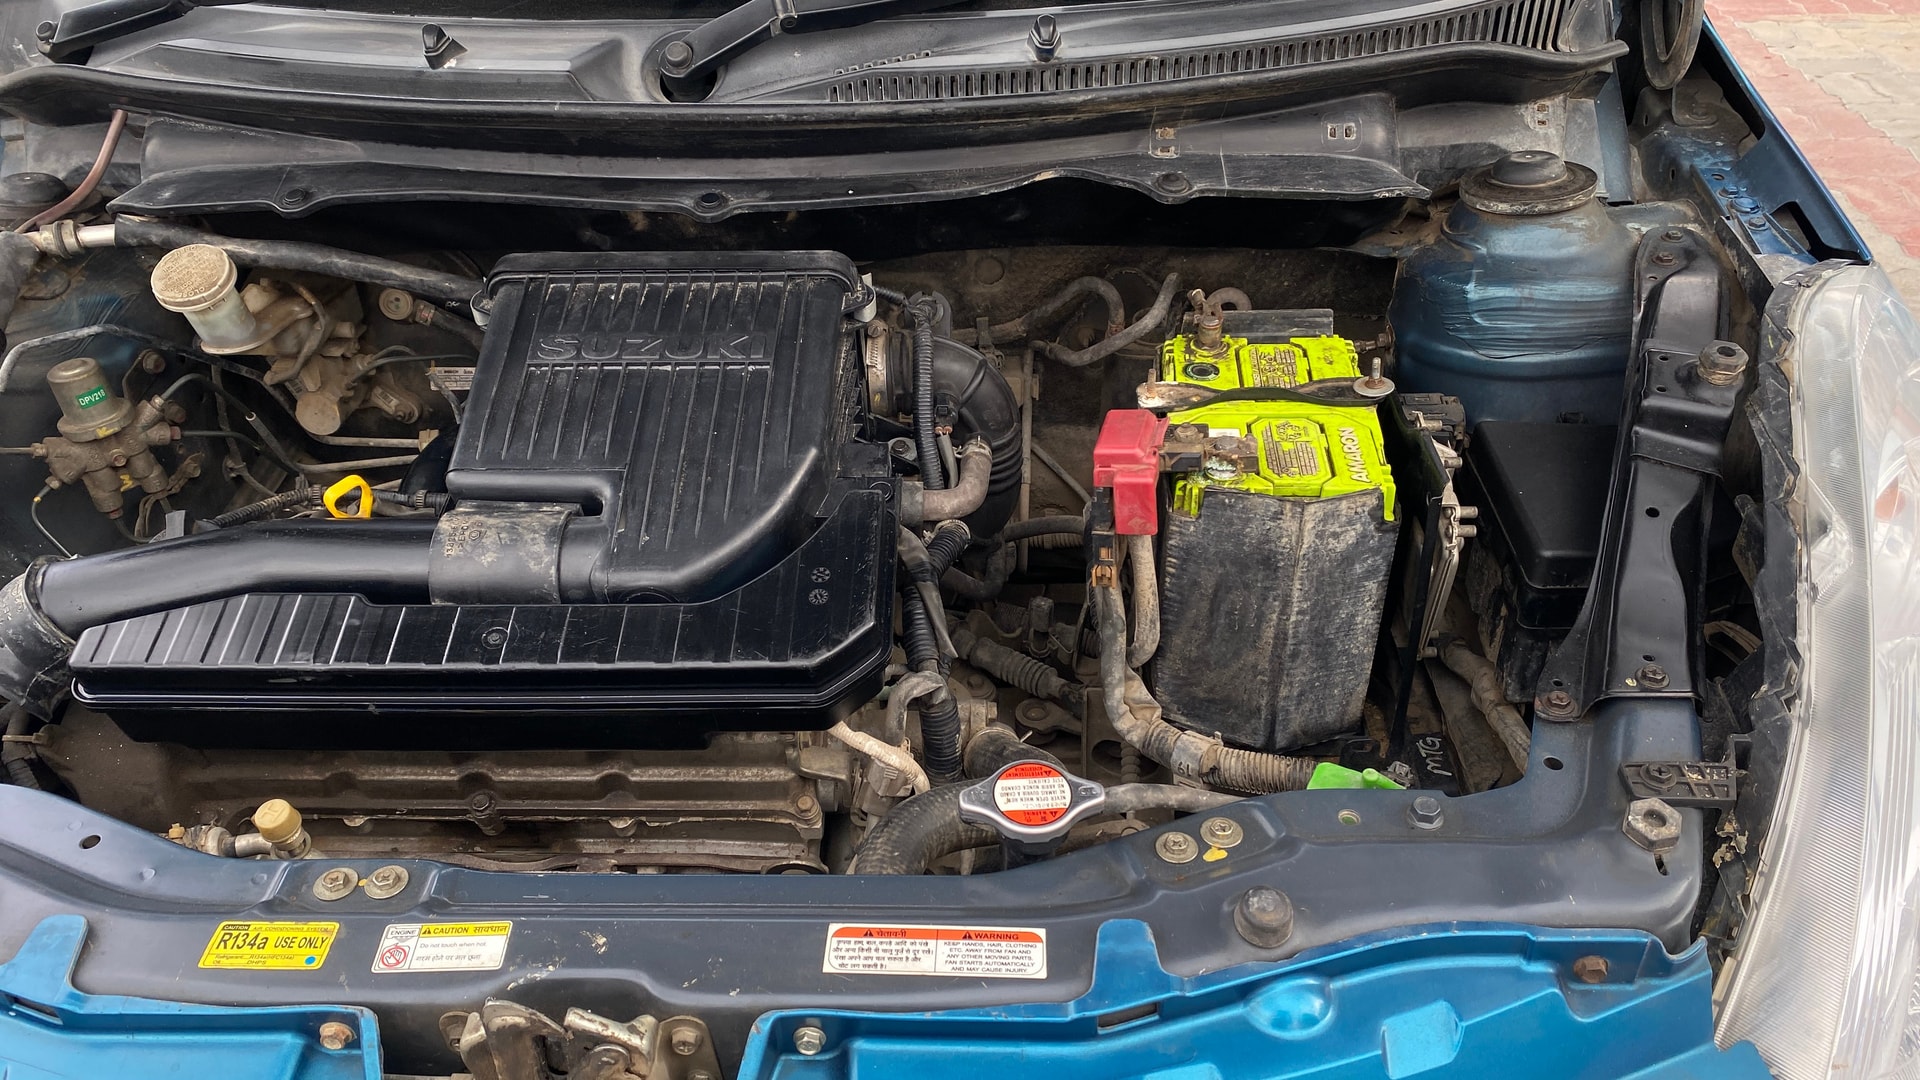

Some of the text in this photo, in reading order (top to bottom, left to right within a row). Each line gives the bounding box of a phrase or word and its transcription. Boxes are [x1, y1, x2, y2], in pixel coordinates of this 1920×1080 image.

[537, 335, 766, 359] SUZUKI
[78, 389, 106, 406] DPV218
[1338, 427, 1372, 483] AMARON
[433, 926, 469, 935] CAUTION
[473, 925, 508, 933] सावधान
[877, 929, 907, 938] चेतावनी
[215, 932, 329, 950] R134a USE ONLY
[974, 932, 1019, 940] WARNING
